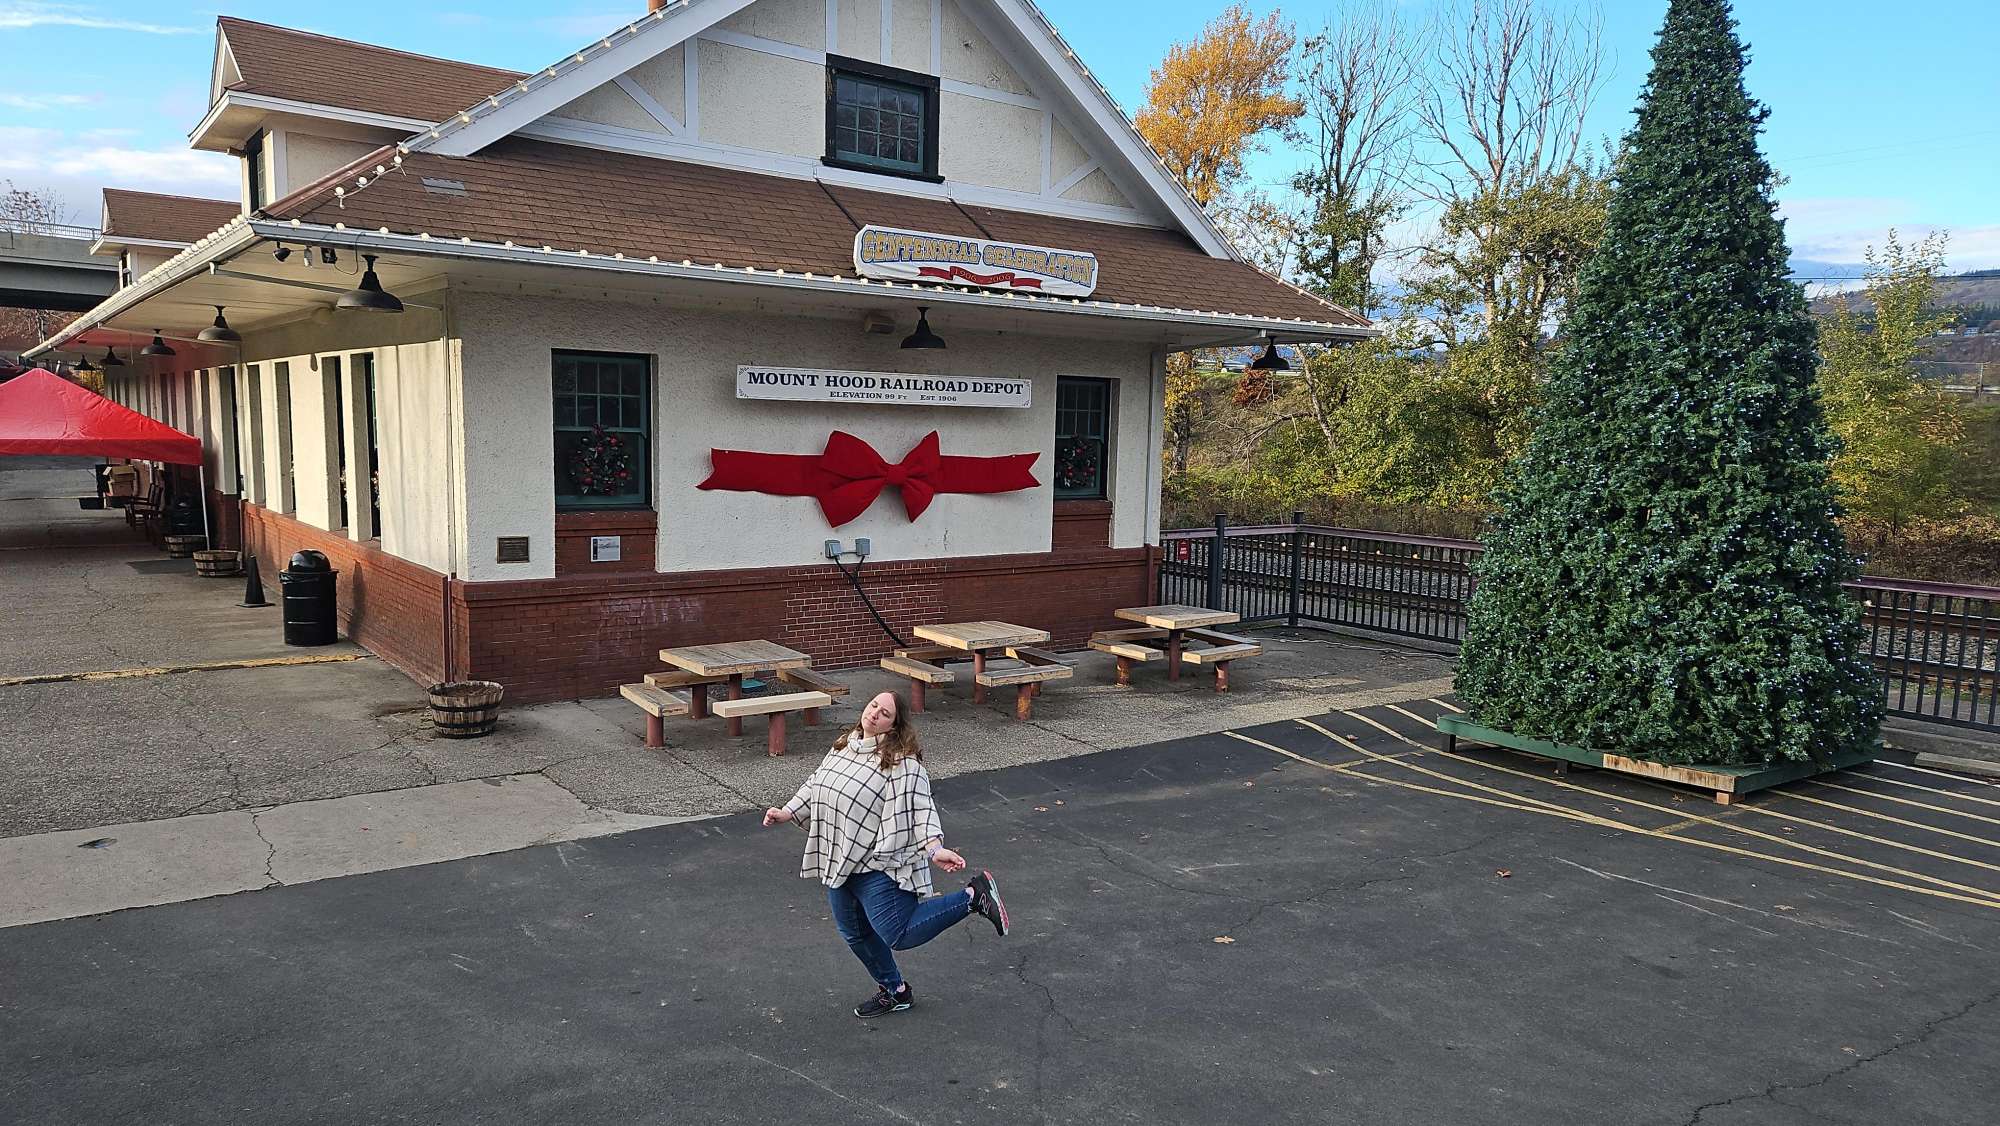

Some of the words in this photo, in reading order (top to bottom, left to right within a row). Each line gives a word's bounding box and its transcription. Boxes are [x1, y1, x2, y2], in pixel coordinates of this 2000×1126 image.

[861, 230, 980, 264] CENTENNIAL
[982, 244, 1095, 288] CELEBRATION
[954, 269, 977, 281] 1906
[747, 371, 819, 387] MOUNT
[825, 375, 876, 389] HOOD
[880, 377, 968, 393] RAILROAD
[972, 381, 1024, 395] DEPOT
[830, 391, 882, 399] ELEVATION
